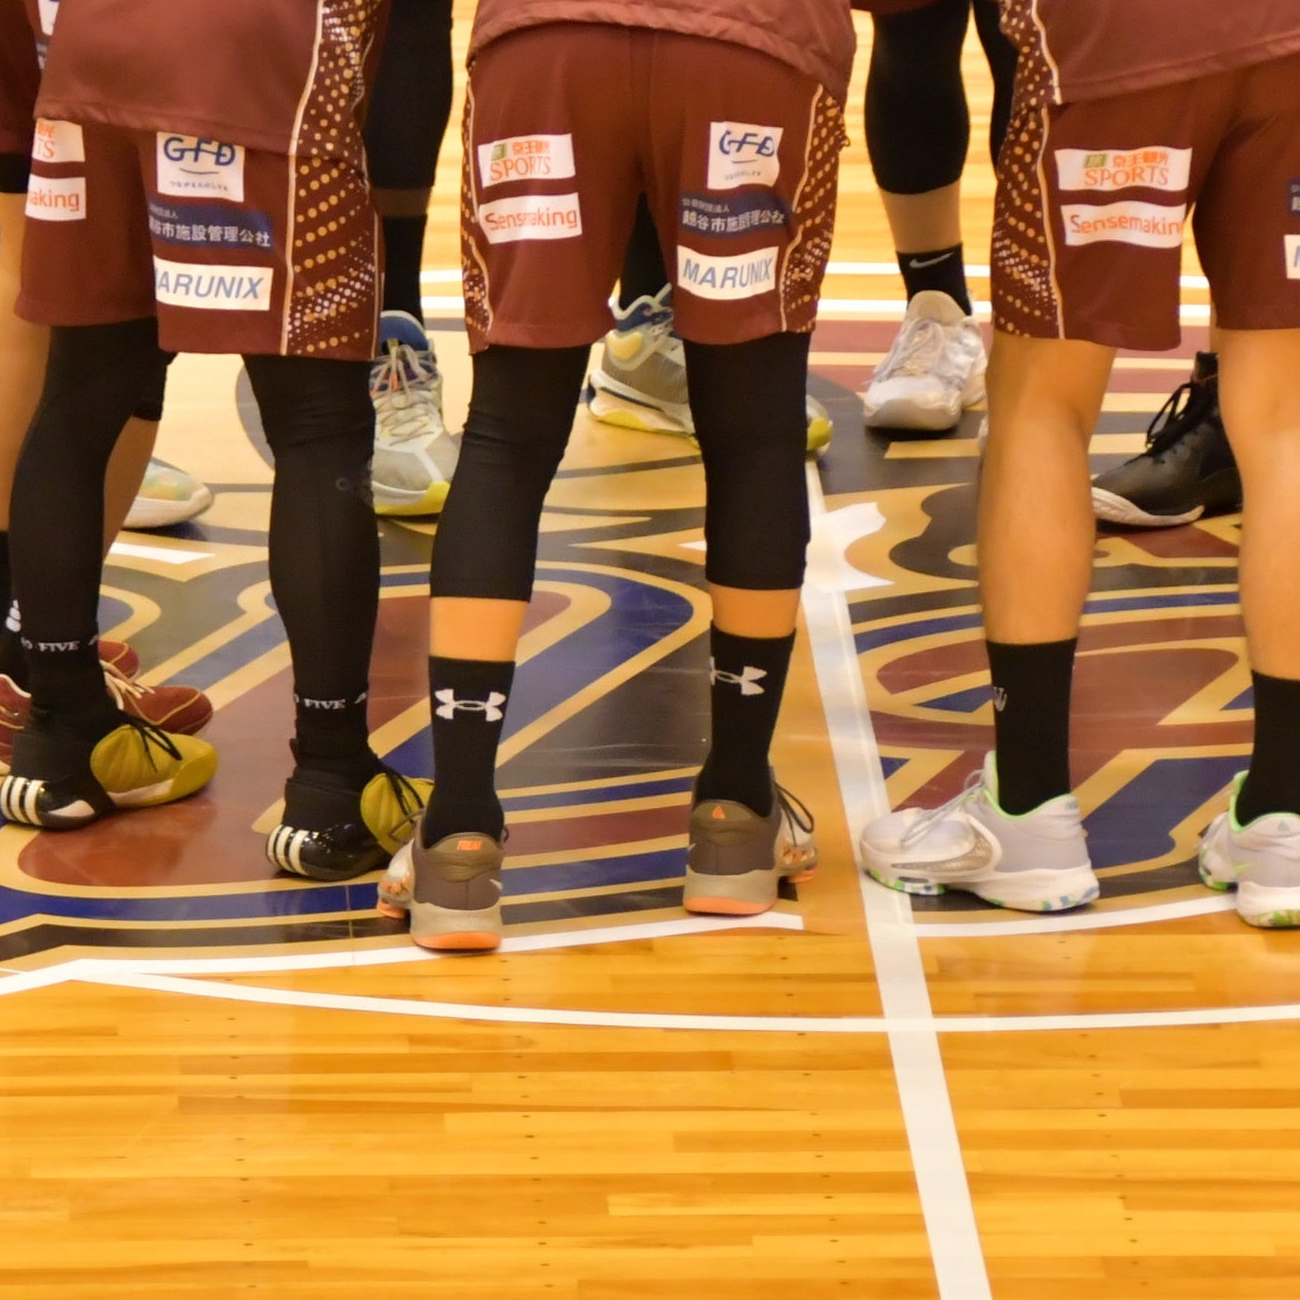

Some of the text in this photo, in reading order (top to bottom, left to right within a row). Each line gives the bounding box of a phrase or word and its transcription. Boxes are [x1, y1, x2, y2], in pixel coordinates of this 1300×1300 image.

[163, 136, 236, 167] GFD
[489, 155, 551, 182] SPORTS
[1084, 166, 1170, 186] SPORTS
[1070, 212, 1183, 236] Sensemakin
[683, 257, 772, 290] MARUNIX
